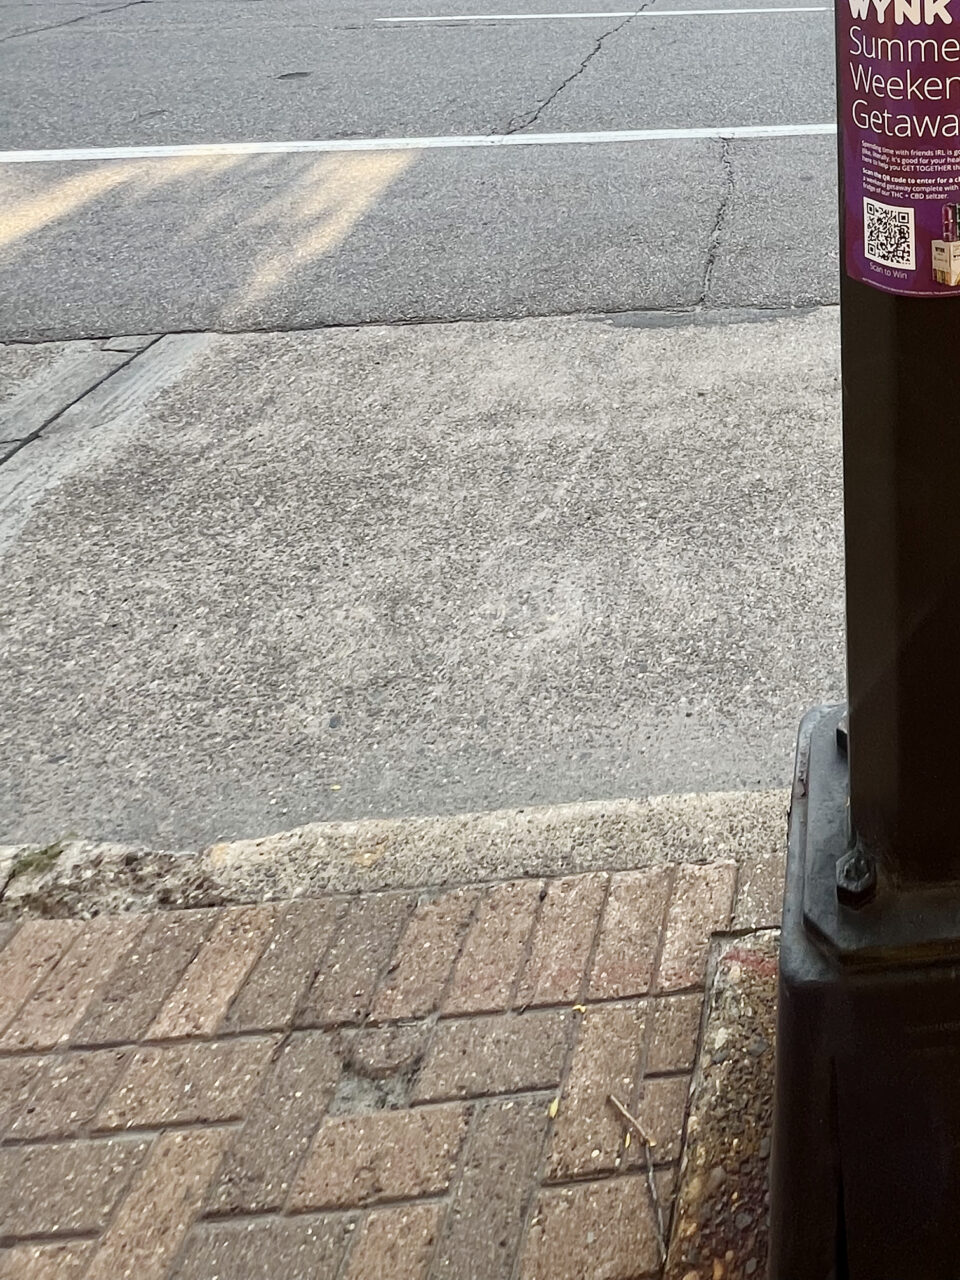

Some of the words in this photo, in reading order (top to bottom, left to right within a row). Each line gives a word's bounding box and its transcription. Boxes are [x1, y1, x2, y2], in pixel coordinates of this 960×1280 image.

[912, 185, 943, 193] complete
[891, 191, 904, 199] THC
[910, 192, 925, 200] CBD
[869, 261, 884, 274] Scan
[884, 268, 892, 276] to
[891, 269, 908, 280] Win
